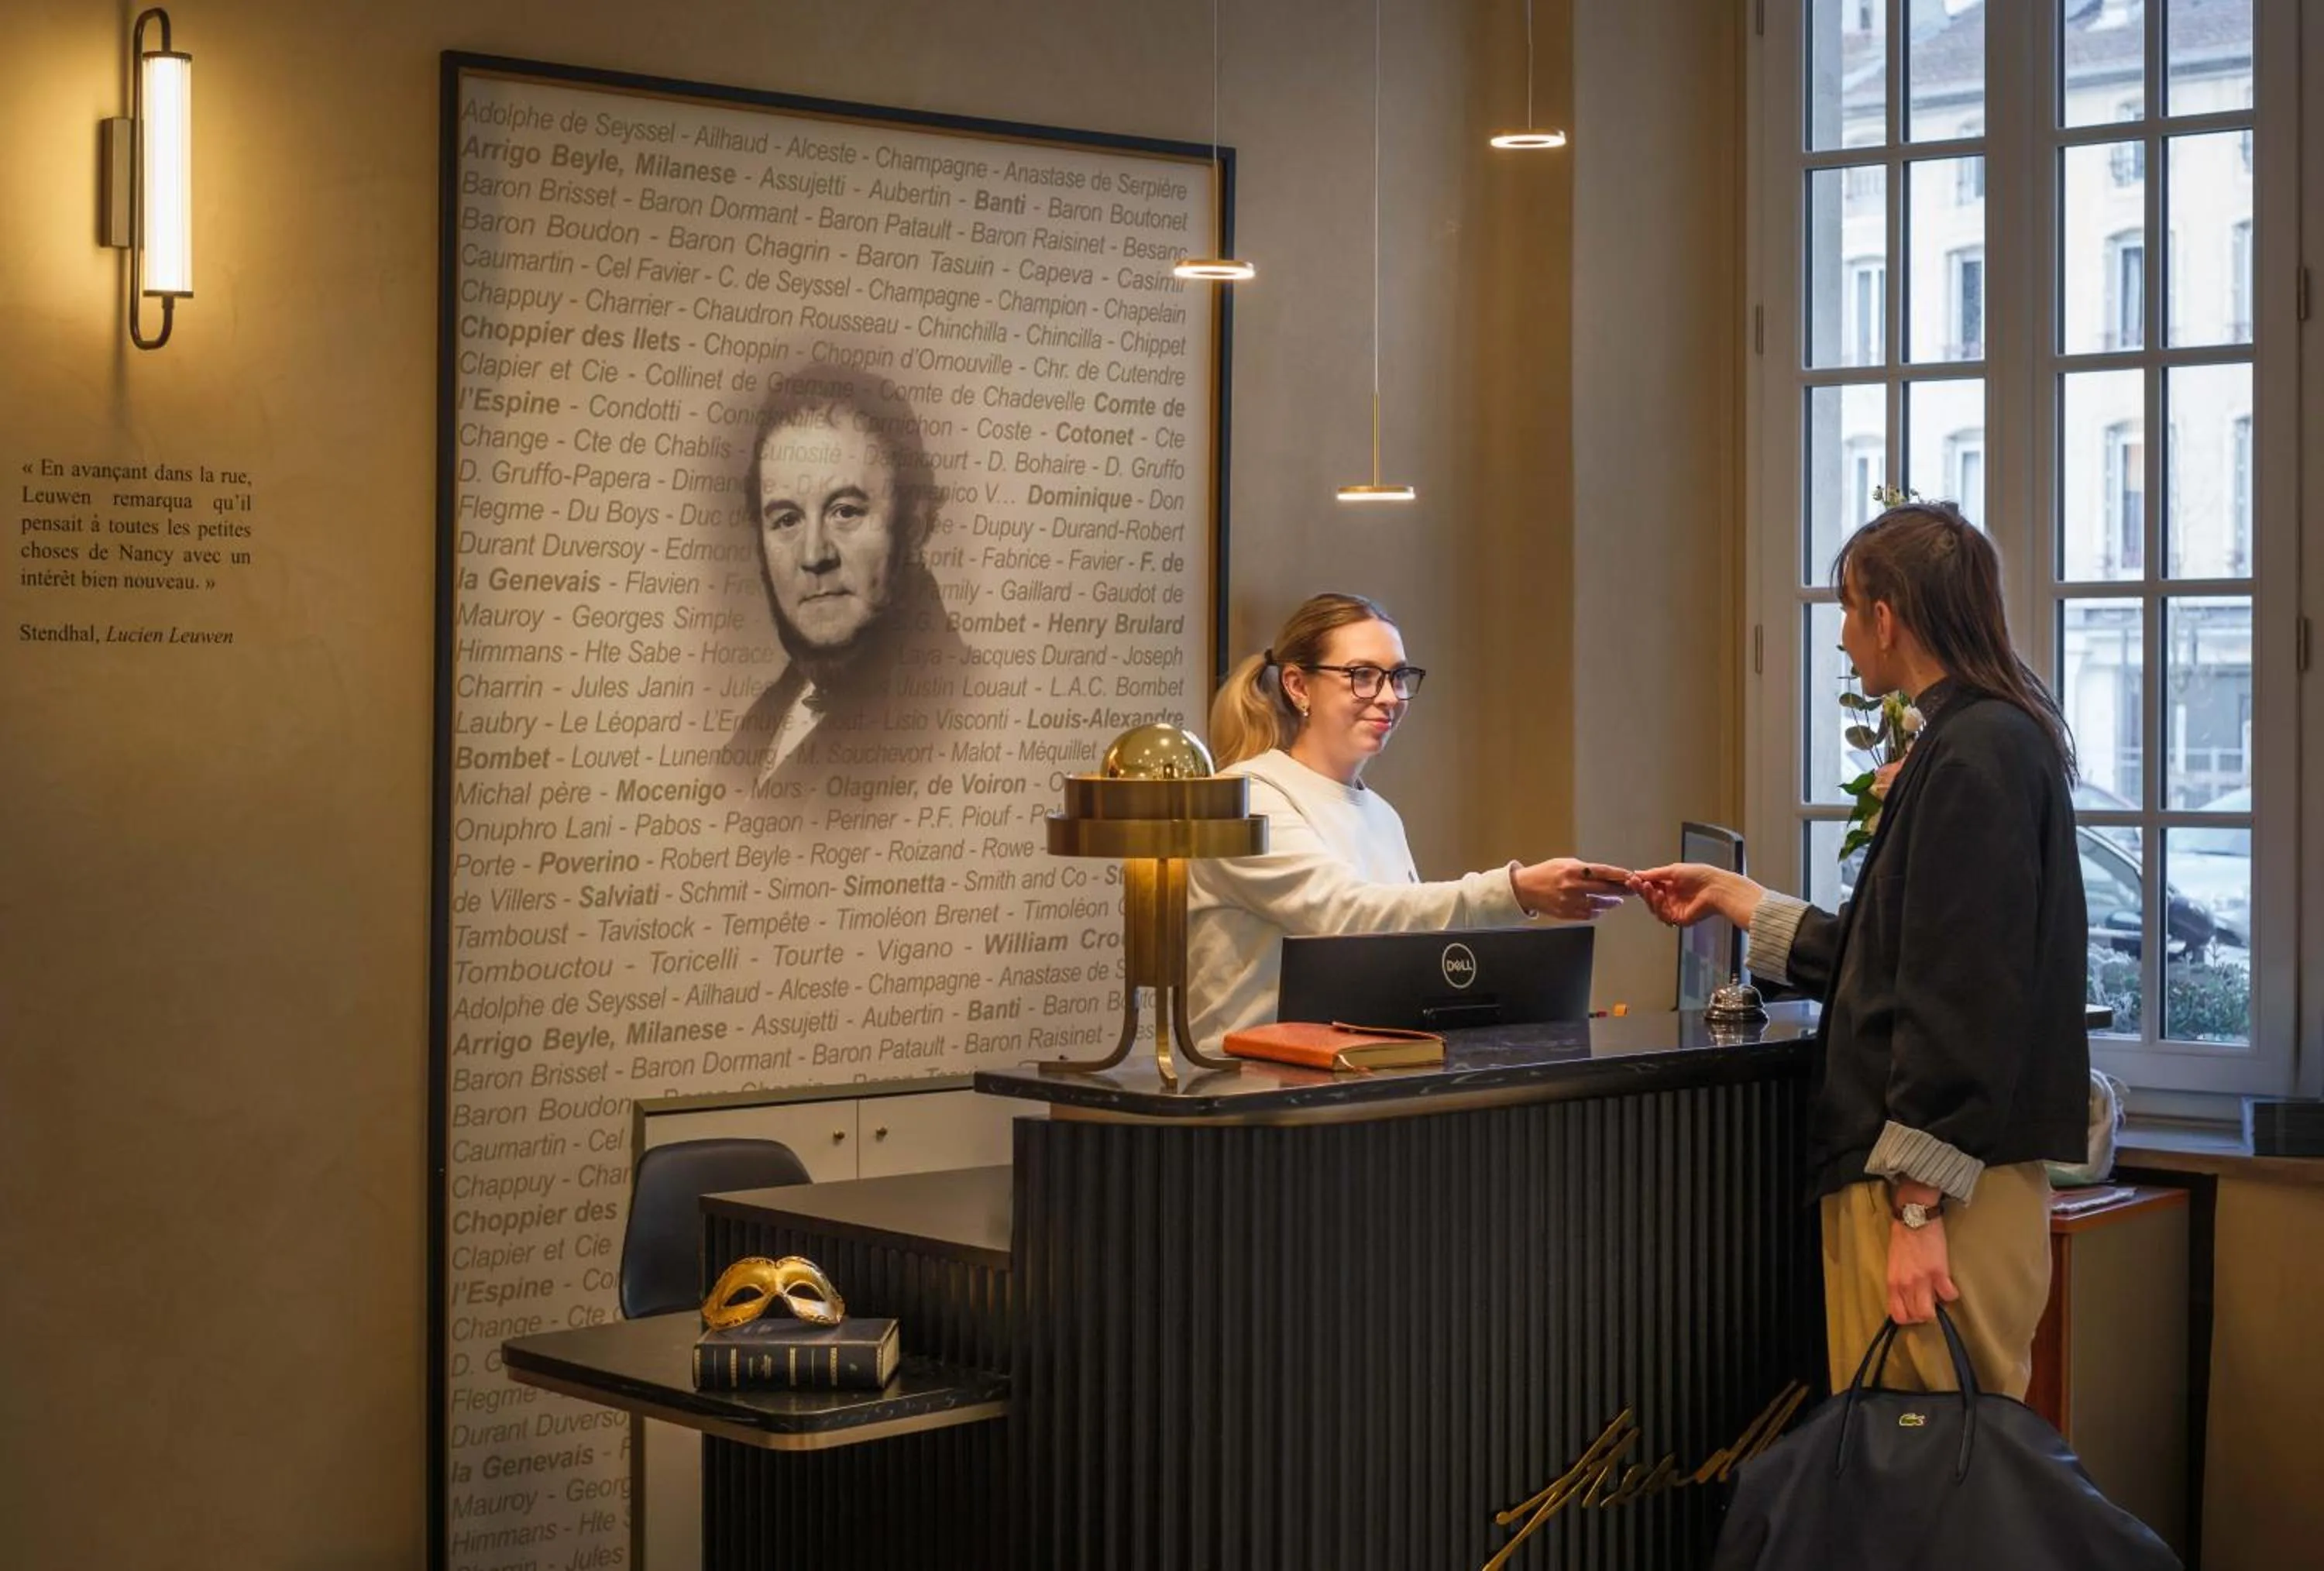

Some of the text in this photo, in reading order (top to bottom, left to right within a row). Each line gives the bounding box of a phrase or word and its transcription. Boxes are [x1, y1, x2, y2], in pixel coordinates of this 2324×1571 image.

[462, 98, 1187, 201] Adolphe de Seyssel Ailhaud Alceste Champagne Anastase de Serpière
[461, 135, 1188, 231] Arrigo Beyle, Milanese Assujetti Aubertin Banti Baron Boutonet
[461, 170, 531, 199] Baron
[538, 177, 617, 208] Brisset
[638, 187, 703, 215] Baron
[709, 194, 798, 225] Dormant
[818, 205, 878, 232] Baron
[884, 213, 952, 240] Patault
[971, 222, 1026, 247] Baron
[1032, 227, 1105, 254] Raisinet
[460, 242, 1186, 326] Caumartin Cel Favier C. de Seyssel Champagne Champion Chapelain
[460, 278, 1186, 359] Chappuy Charrier Chaudron Rousseau Chinchilla Chincilla Chippet
[460, 314, 575, 348] Choppier
[581, 324, 624, 348] des
[704, 332, 789, 363] Choppin
[810, 341, 893, 370] Choppin
[1033, 356, 1068, 378] Chr.
[1076, 359, 1100, 381] de
[1106, 360, 1185, 387] Cutendre
[459, 387, 1185, 449] l'Espine Condotti Coste Cotonet Cte
[40, 459, 64, 476] En
[71, 464, 148, 483] avançant
[154, 463, 193, 482] dans
[200, 466, 215, 483] la
[220, 470, 253, 487] rue,
[22, 486, 91, 505] Leuwen
[112, 493, 192, 513] remarqua
[459, 494, 1185, 543] Flegme Du Boys Duc Dupuy Durand-Robert
[21, 515, 83, 535] pensait
[108, 518, 159, 535] toutes
[167, 517, 191, 536] les
[198, 521, 252, 541] petites
[20, 541, 251, 567] choses de Nancy avec un
[459, 531, 1184, 572] Durant Duversoy Fabrice Favier F. de
[81, 569, 118, 589] bien
[124, 576, 200, 590] nouveau.
[19, 624, 234, 645] Stendhal, Lucien Leuwen
[458, 602, 545, 633] Mauroy
[572, 604, 664, 634] Georges
[947, 612, 1026, 634] Bombet
[1047, 612, 1108, 639] Henry
[1115, 613, 1184, 634] Brulard
[458, 674, 1184, 698] Charrin Jules Janin Louaut L.A.C. Bombet
[455, 772, 1026, 810] Michal père Mocenigo Olagnier, de Voiron
[455, 816, 557, 846] Onuphro
[565, 815, 613, 839] Lani
[634, 813, 702, 837] Pabos
[724, 810, 803, 839] Pagaon
[917, 806, 952, 828] P.F.
[961, 804, 1012, 827] Piouf
[454, 890, 481, 913] de
[490, 888, 556, 912] Villers
[578, 883, 659, 909] Salviati
[679, 879, 748, 903] Schmit
[843, 874, 945, 896] Simonetta
[964, 870, 1016, 892] Smith
[1021, 867, 1056, 889] and
[1061, 866, 1087, 888] Co
[454, 897, 1109, 949] Tamboust Tavistock Tempête Timoléon Brenet Timoléon
[454, 931, 1068, 985] Tombouctou Toricelli Tourte Vigano William
[1446, 960, 1473, 972] DELL
[453, 994, 1098, 1060] Arrigo Beyle, Milanese Assujetti Aubertin Banti Baron
[452, 1277, 554, 1307] l'Espine
[450, 1445, 593, 1483] la Genevais
